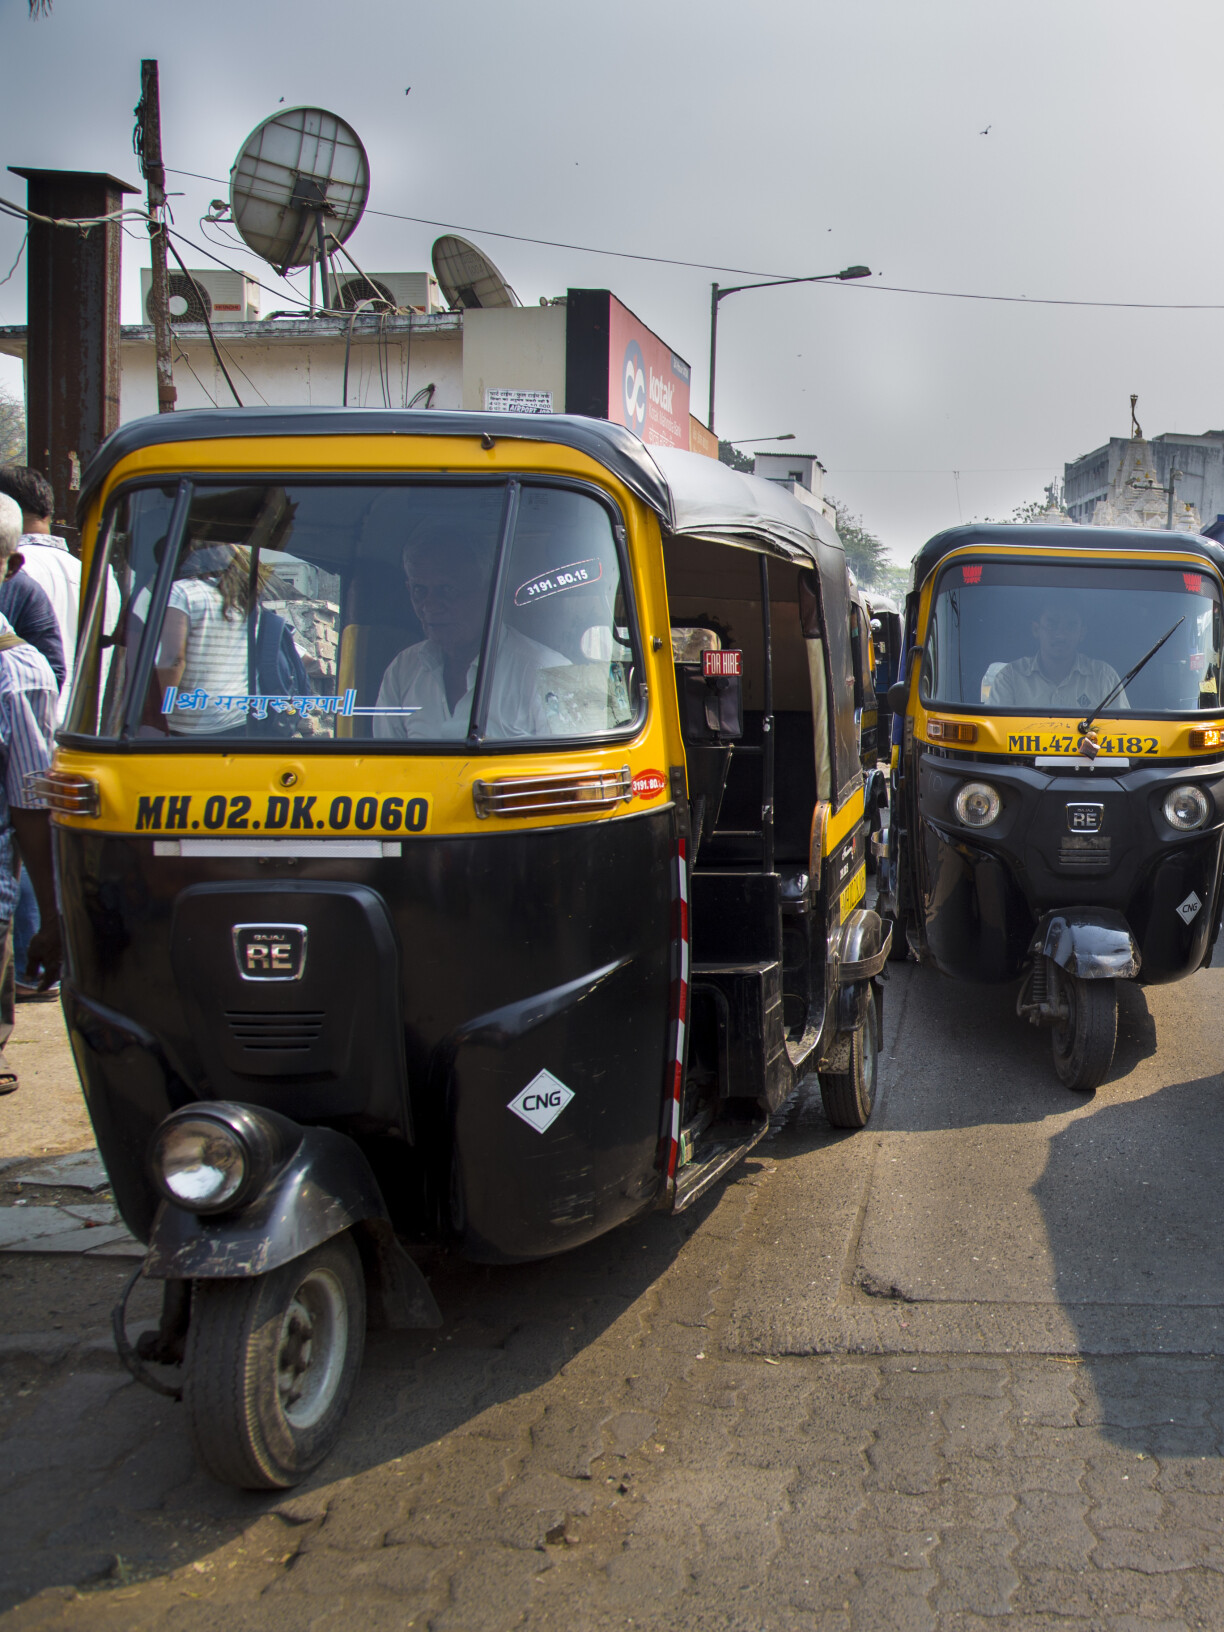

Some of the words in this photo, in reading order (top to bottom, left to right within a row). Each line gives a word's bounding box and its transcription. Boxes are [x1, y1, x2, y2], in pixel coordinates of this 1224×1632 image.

[649, 366, 673, 415] kotak
[527, 578, 557, 596] 3191.
[706, 653, 721, 674] FOR
[723, 653, 740, 675] HIRE
[1008, 734, 1159, 755] MH.47.4182
[136, 795, 429, 832] MH.02.DK.0060
[1073, 813, 1097, 827] RE
[1183, 904, 1198, 913] CNG
[246, 943, 293, 969] RE
[522, 1091, 562, 1112] CNG
